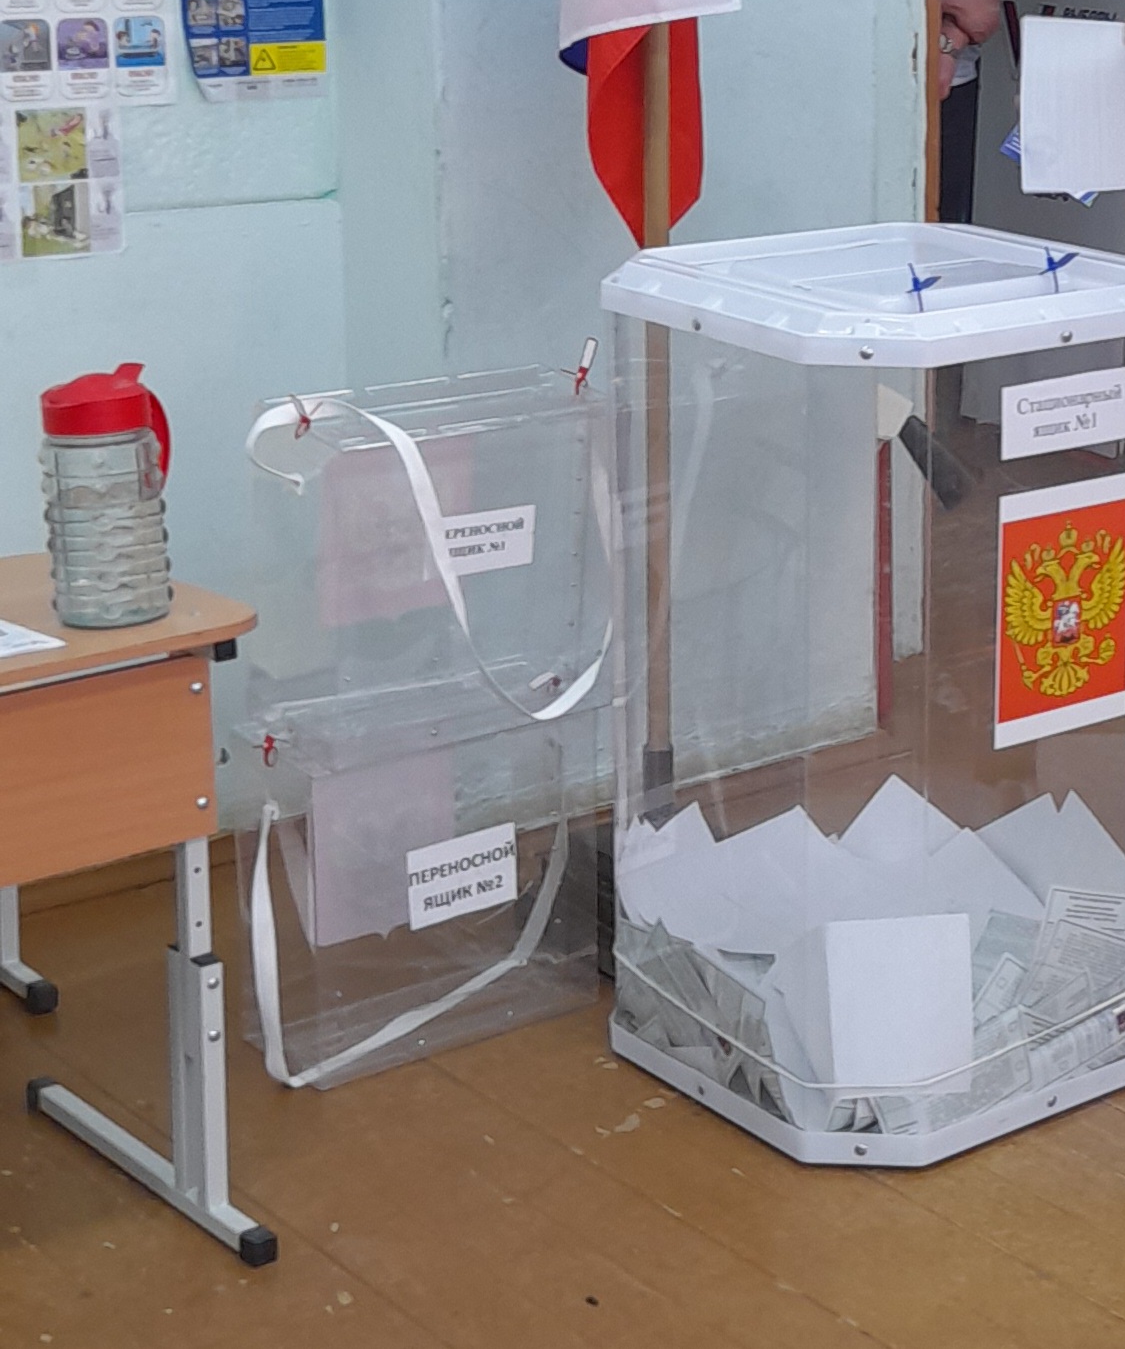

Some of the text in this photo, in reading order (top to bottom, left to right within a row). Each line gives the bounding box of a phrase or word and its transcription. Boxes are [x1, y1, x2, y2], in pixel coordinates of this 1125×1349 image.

[1016, 384, 1122, 415] Стационарный
[1033, 412, 1097, 438] ящик №1
[445, 517, 524, 540] ЕРЕНОСНОЙ
[448, 540, 506, 558] ЩИК №1
[408, 840, 516, 887] ПЕРЕНОСНОЙ
[423, 874, 504, 911] ЯЩИК №2
